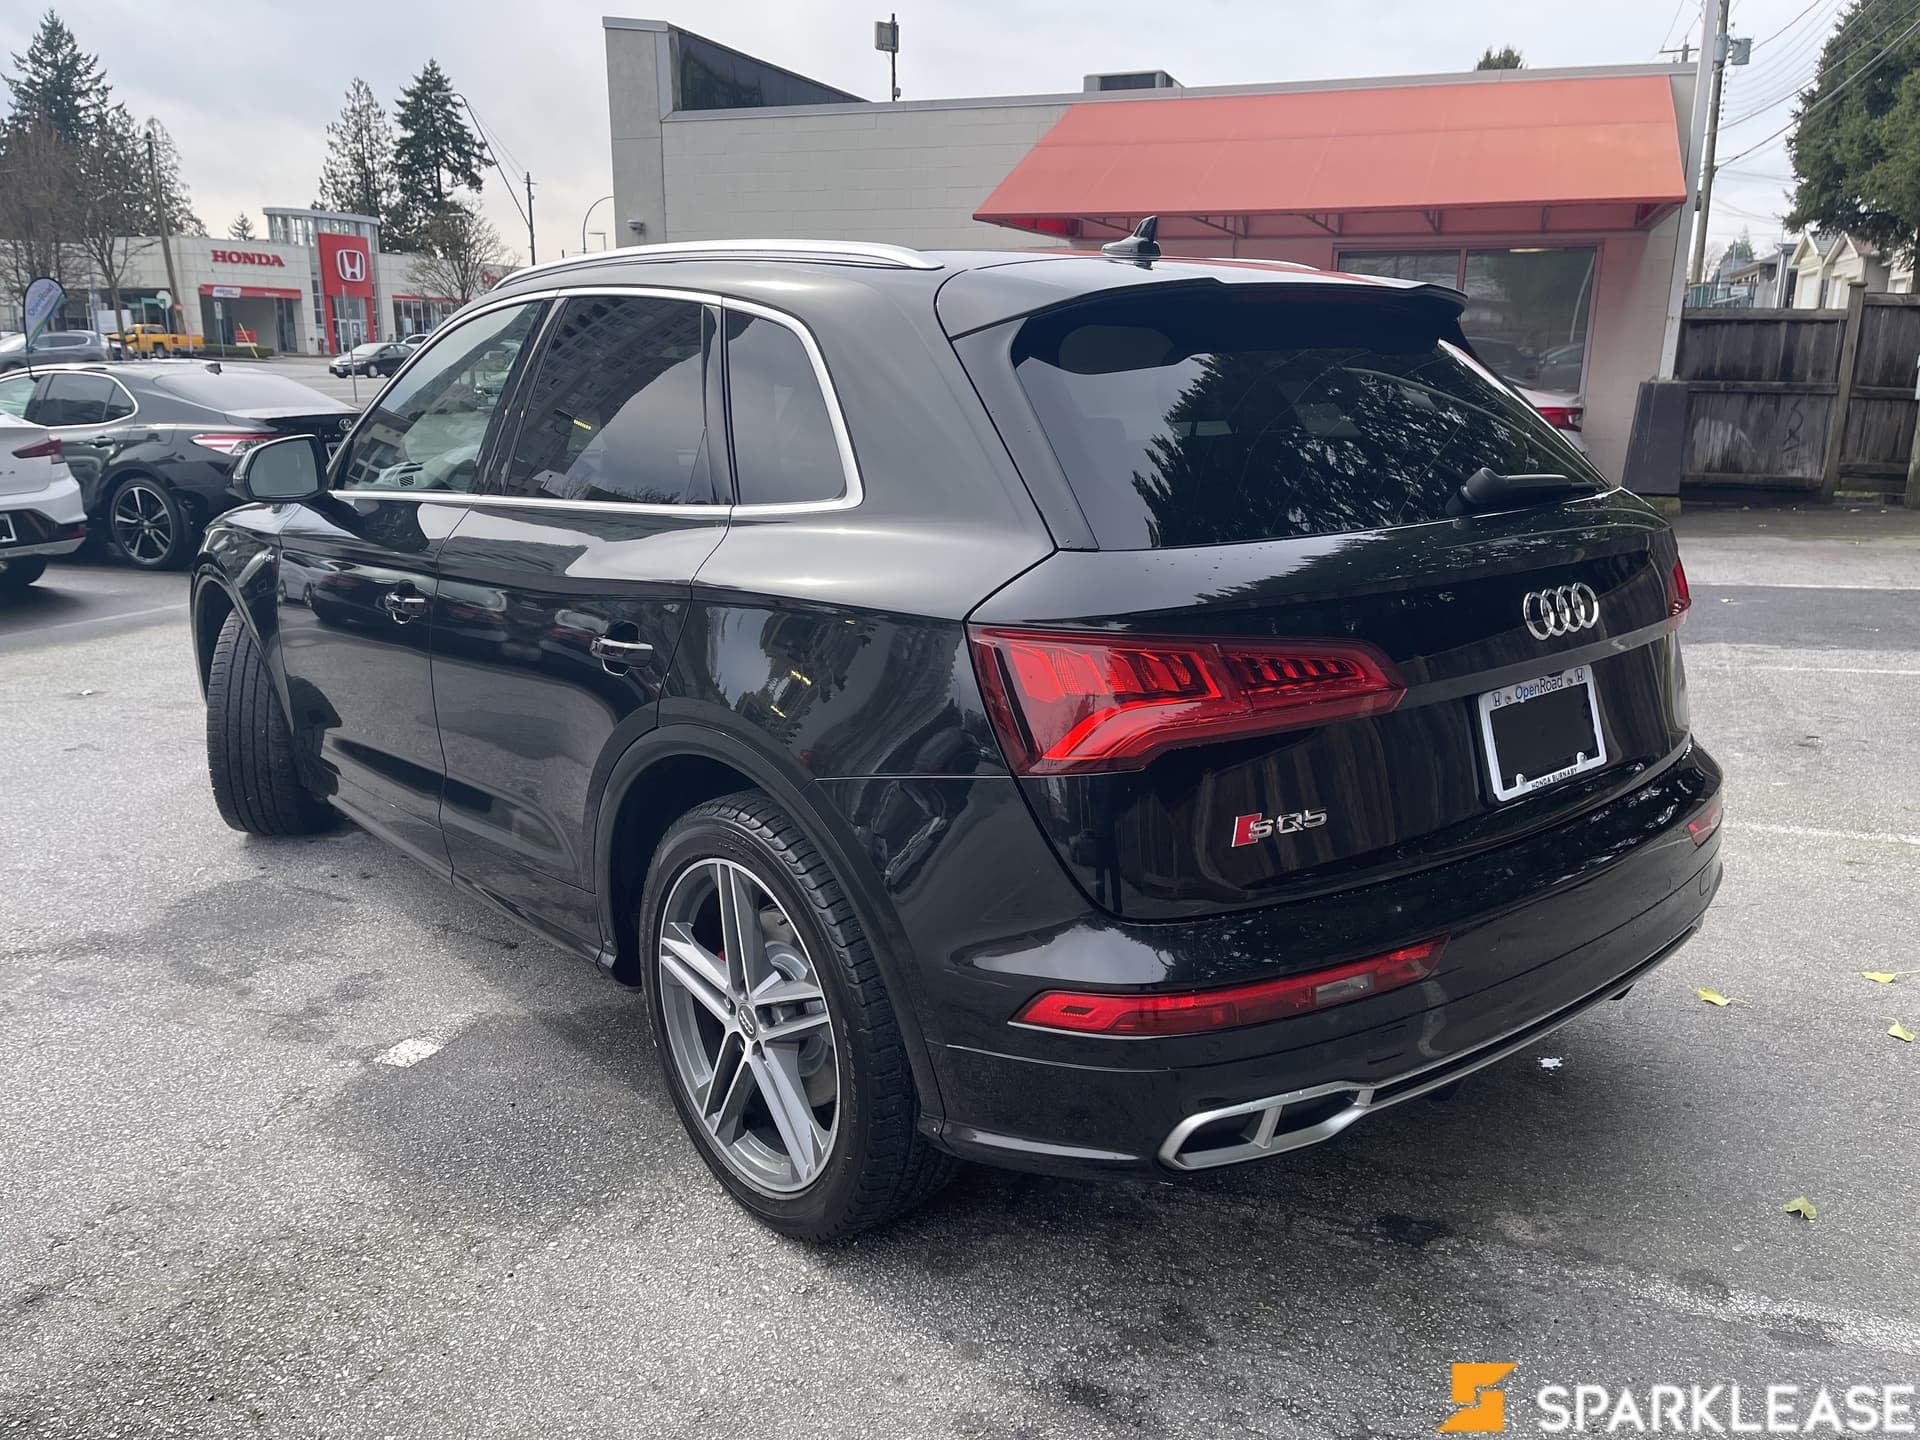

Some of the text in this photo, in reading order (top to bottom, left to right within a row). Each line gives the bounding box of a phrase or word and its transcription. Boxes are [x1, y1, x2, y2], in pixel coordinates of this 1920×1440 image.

[211, 250, 285, 267] HONDA
[1516, 676, 1563, 699] OpenRoad
[1531, 768, 1577, 789] HONDA BURNABY
[1247, 809, 1327, 840] SQ5
